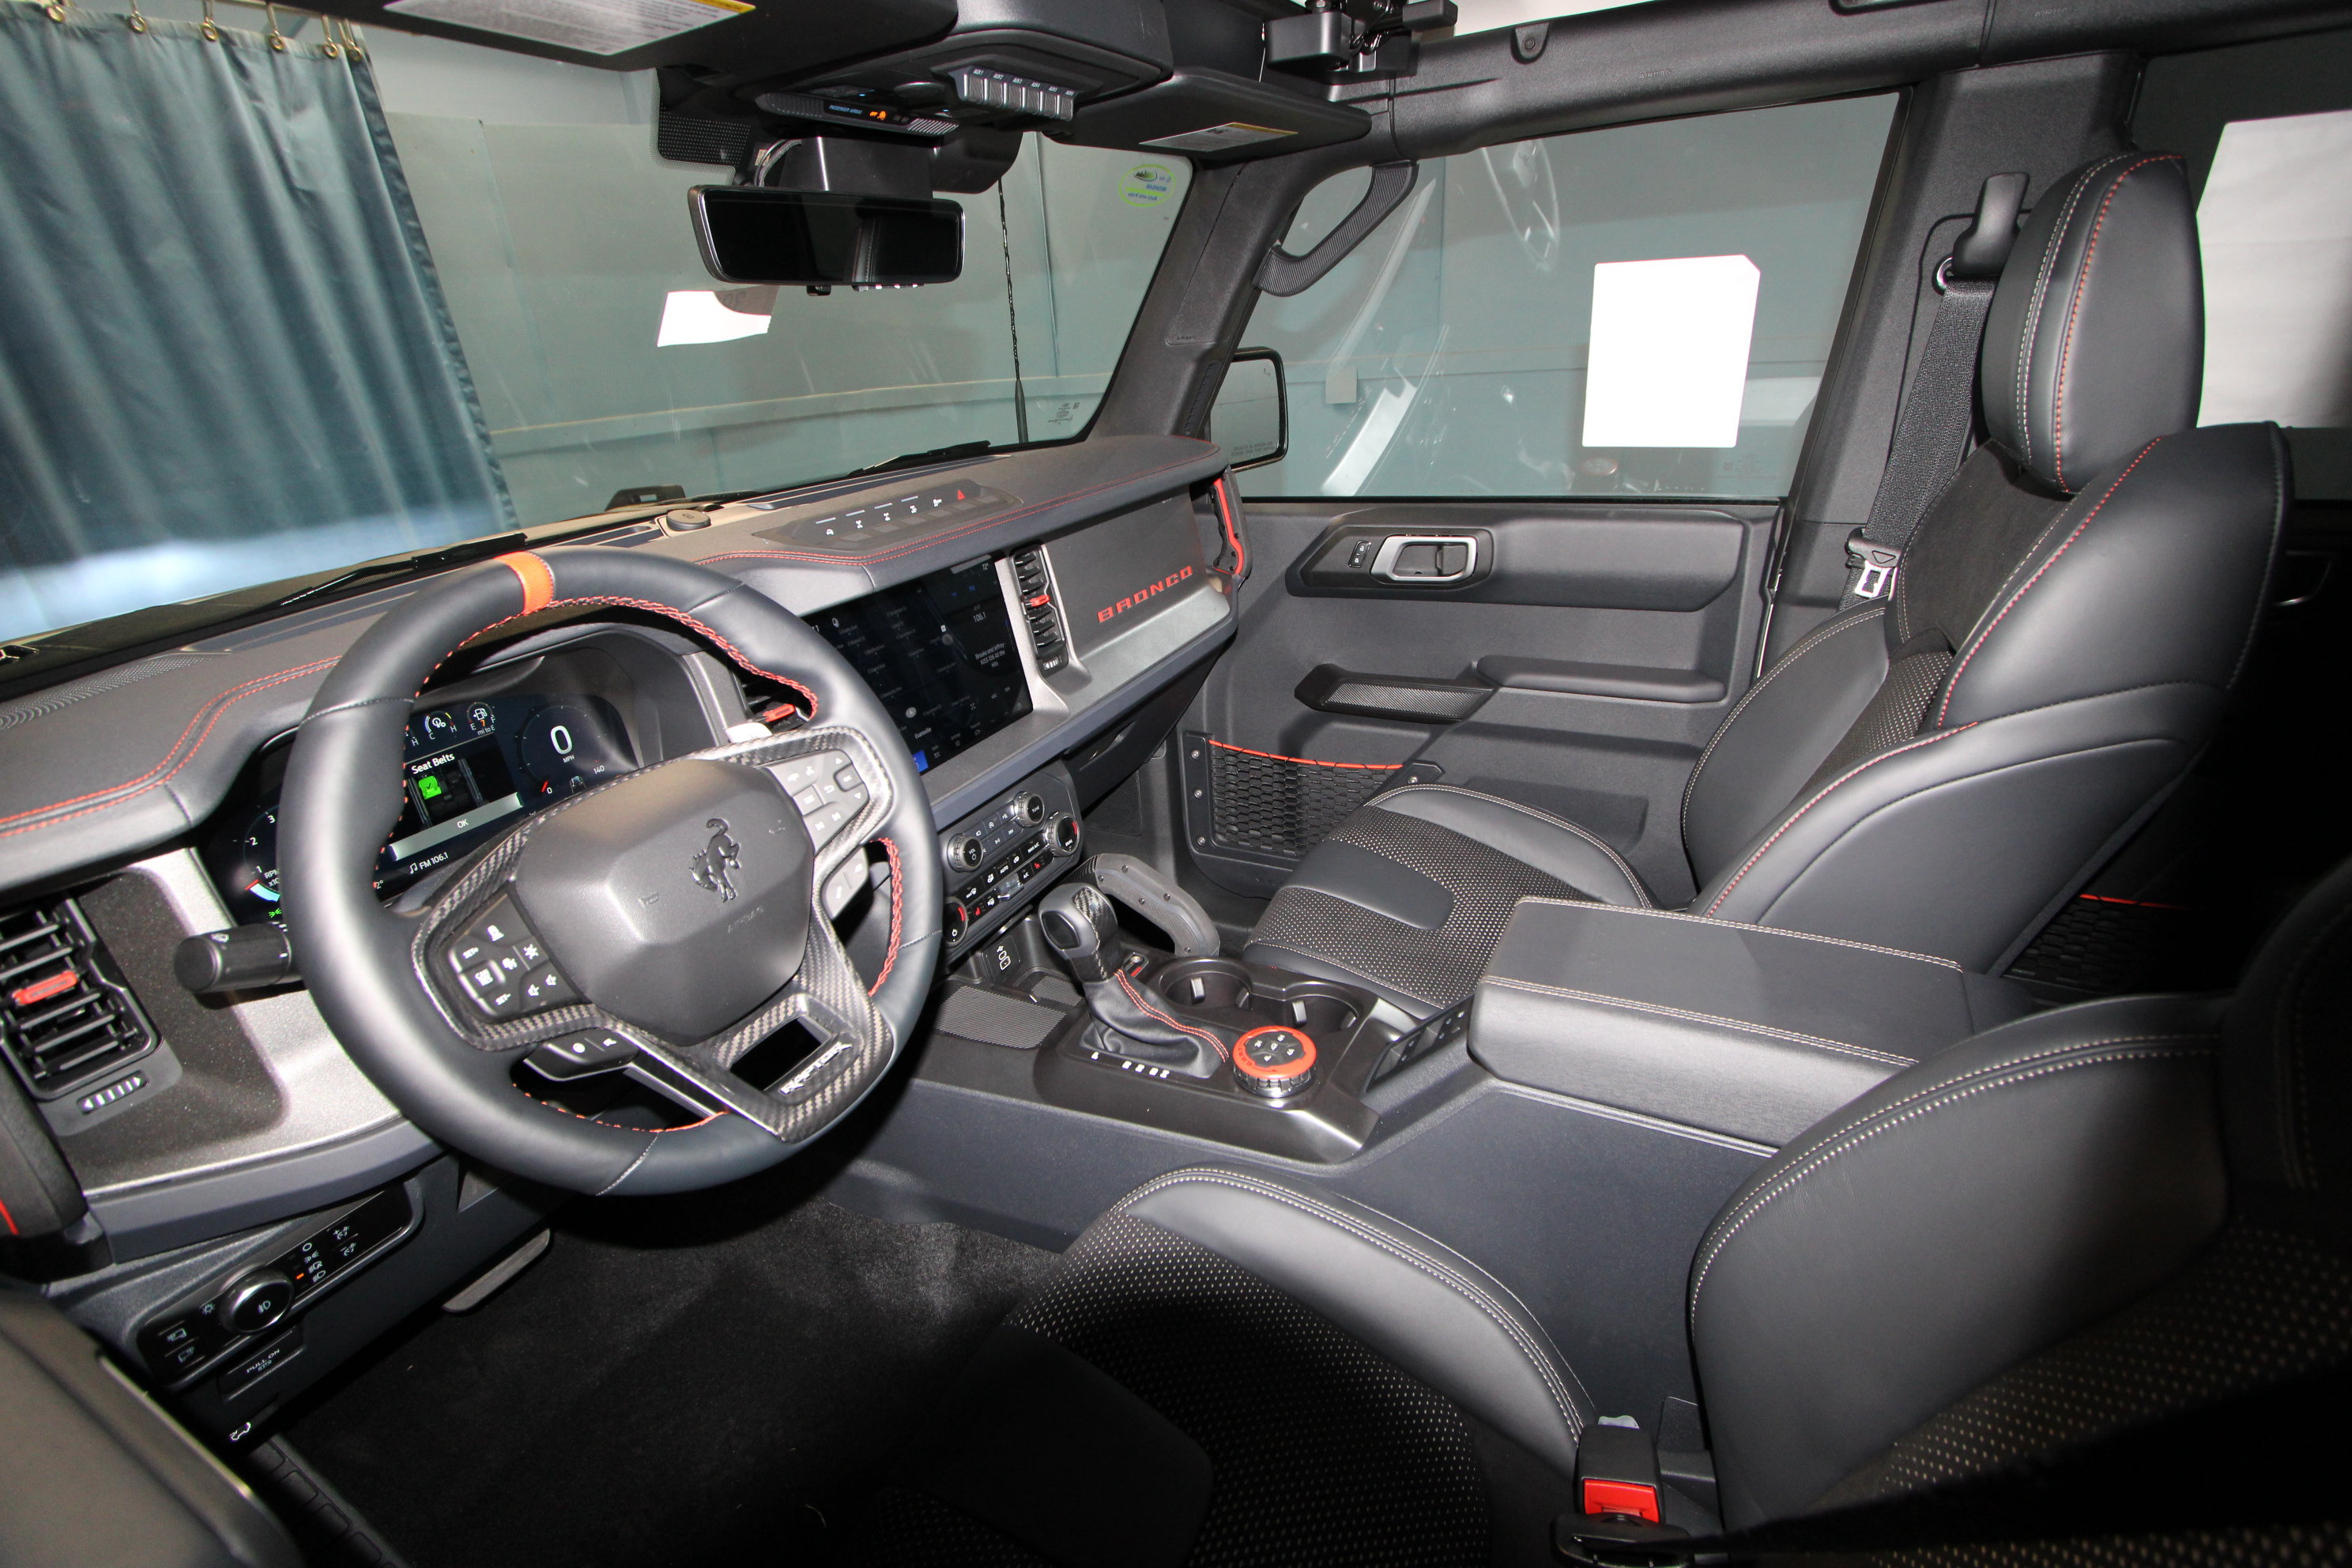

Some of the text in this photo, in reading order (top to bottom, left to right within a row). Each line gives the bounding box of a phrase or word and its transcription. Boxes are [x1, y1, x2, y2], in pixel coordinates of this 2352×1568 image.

[1097, 565, 1193, 623] BRONCO
[973, 612, 986, 623] 106.1
[550, 726, 572, 755] 0
[412, 753, 455, 775] Seat Belts
[563, 755, 575, 763] MPH
[594, 765, 605, 775] 140
[268, 815, 276, 824] 3
[457, 819, 469, 828] OK
[250, 837, 258, 846] 2
[419, 852, 449, 870] FM 106.1
[779, 1042, 852, 1095] RAPTOR
[247, 1348, 280, 1374] PULL ON
